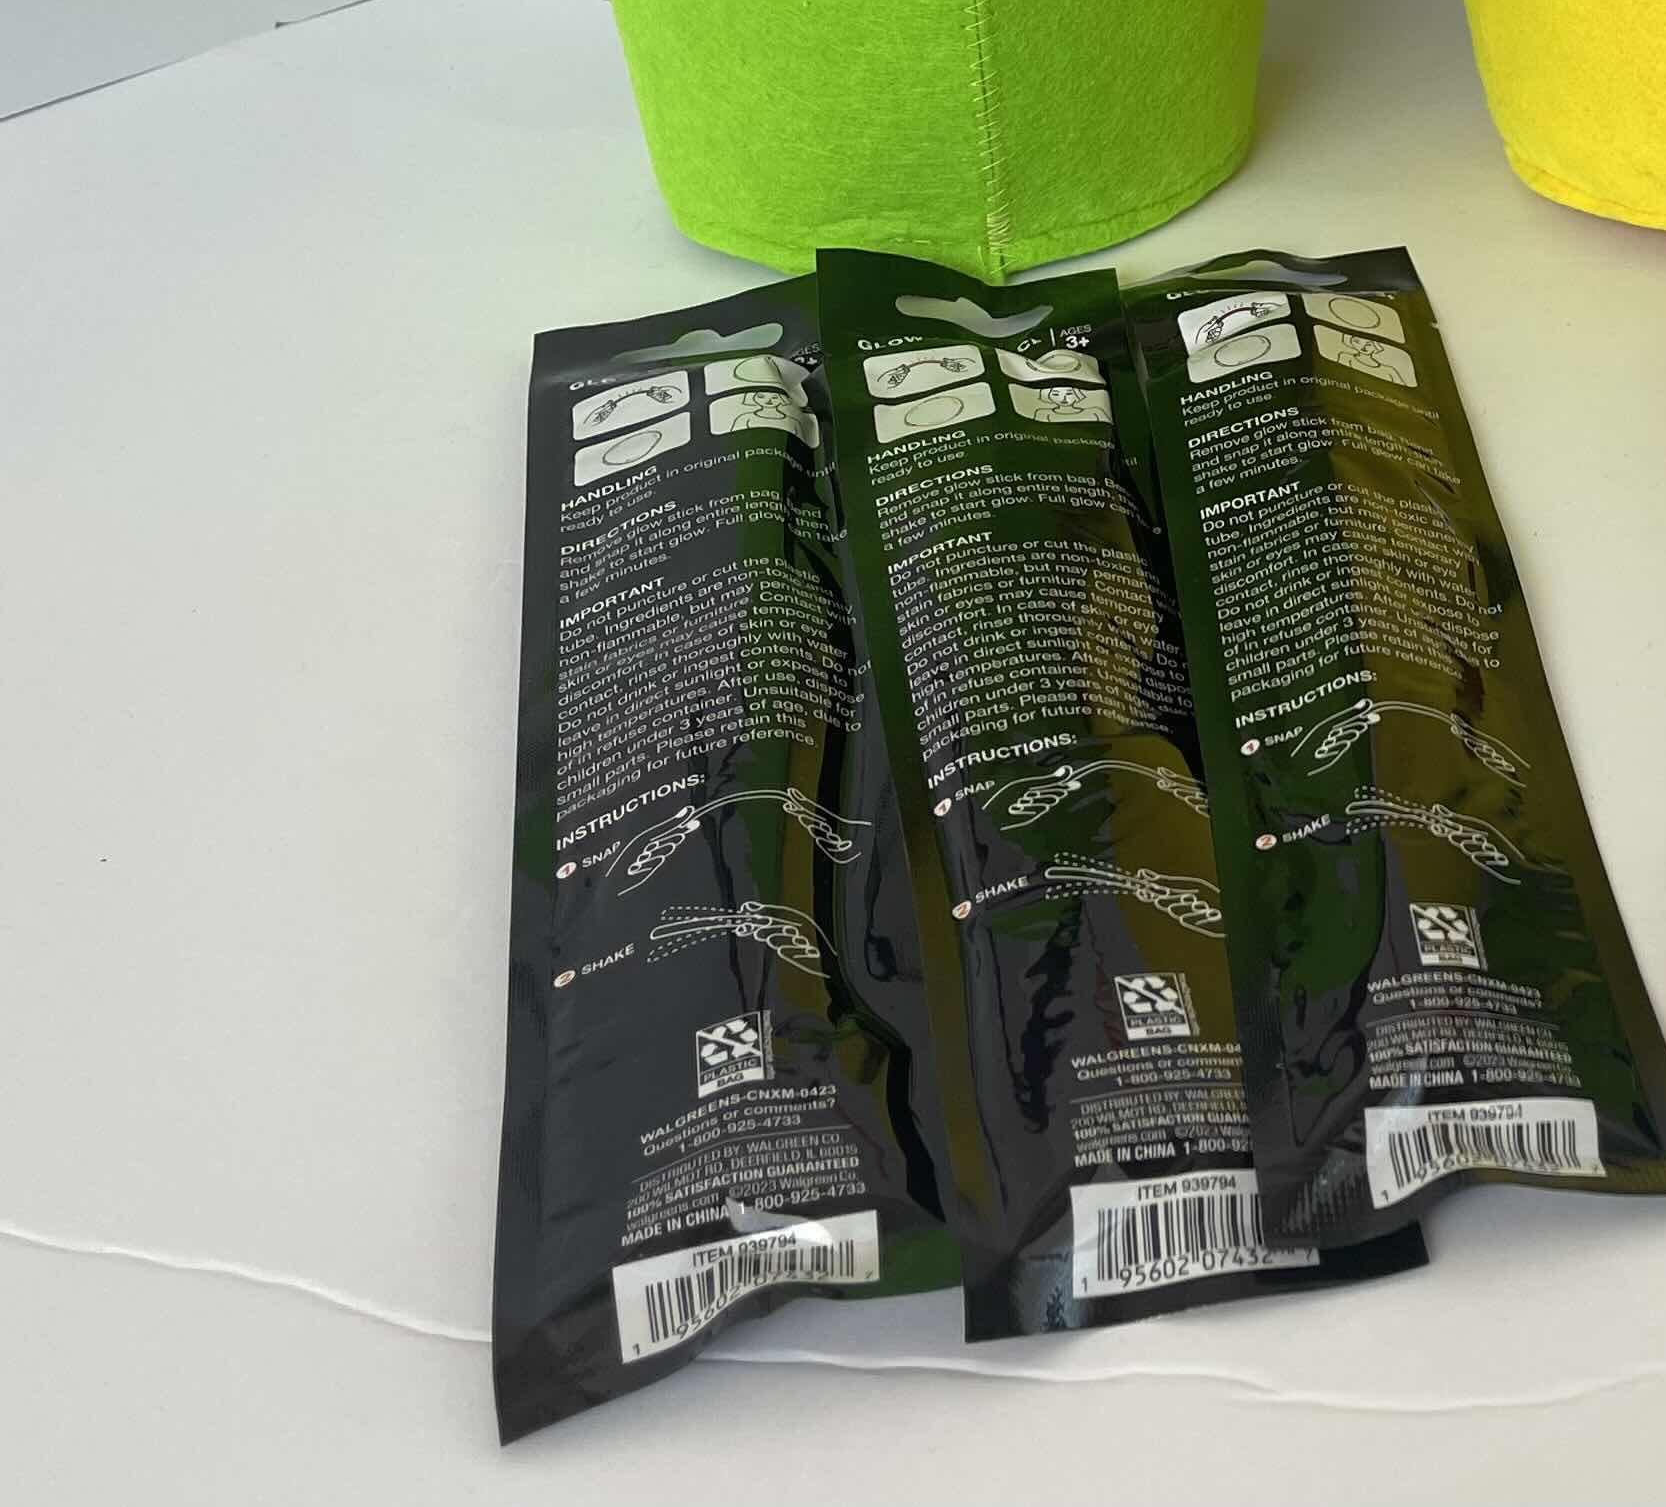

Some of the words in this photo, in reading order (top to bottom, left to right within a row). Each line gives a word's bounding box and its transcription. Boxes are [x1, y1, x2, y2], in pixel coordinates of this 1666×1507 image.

[1059, 324, 1092, 337] AGES
[1065, 335, 1090, 349] 3+
[1180, 371, 1274, 406] HANDLING
[1181, 399, 1221, 417] Keep
[1224, 379, 1279, 404] product
[1300, 376, 1351, 390] original
[1184, 408, 1224, 428] ready
[1187, 406, 1300, 449] DIRECTIONS
[867, 430, 966, 464] HANDLING
[868, 457, 909, 474] Keep
[913, 439, 973, 464] product
[1190, 434, 1251, 460] Remove
[1254, 423, 1287, 443] glow
[1292, 417, 1328, 429] stick
[560, 504, 601, 523] Keep
[606, 475, 662, 512] product
[683, 450, 740, 478] original
[560, 465, 658, 512] HANDLING
[871, 465, 912, 485] ready
[875, 465, 994, 507] DIRECTIONS
[1209, 473, 1235, 489] few
[1240, 455, 1304, 478] minutes.
[877, 487, 939, 518] Remove
[944, 478, 981, 497] glow
[986, 472, 1023, 484] stick
[1027, 472, 1063, 482] from
[1200, 481, 1300, 520] IMPORTANT
[1202, 521, 1225, 534] Do
[1229, 513, 1253, 527] not
[1258, 484, 1323, 518] puncture
[560, 514, 604, 533] ready
[560, 500, 678, 556] DIRECTIONS
[628, 543, 664, 562] start
[715, 513, 744, 529] Full
[898, 531, 926, 546] few
[929, 509, 996, 536] minutes.
[887, 532, 993, 574] IMPORTANT
[575, 583, 600, 599] few
[604, 554, 671, 582] minutes.
[559, 626, 582, 642] Do
[587, 613, 611, 628] not
[616, 582, 687, 616] puncture
[713, 561, 737, 577] cut
[559, 577, 664, 629] IMPORTANT
[605, 591, 694, 636] Ingredients
[672, 632, 761, 666] thoroughly
[1227, 656, 1271, 686] small
[1324, 631, 1378, 651] Please
[1231, 665, 1315, 702] packaging
[1319, 653, 1340, 668] for
[1344, 642, 1391, 656] future
[919, 713, 960, 745] small
[1019, 690, 1078, 707] Please
[1235, 670, 1377, 729] INSTRUCTIONS:
[922, 717, 1008, 762] packaging
[1013, 710, 1037, 726] for
[1041, 705, 1092, 718] future
[1264, 726, 1304, 746] SNAP
[556, 769, 641, 822] packaging
[647, 755, 671, 772] for
[675, 737, 728, 761] future
[927, 733, 1077, 789] INSTRUCTIONS:
[954, 780, 996, 801] SNAP
[556, 774, 706, 850] INSTRUCTIONS:
[1283, 814, 1331, 843] SHAKE
[582, 841, 621, 868] SNAP
[975, 876, 1029, 904] SHAKE
[581, 943, 635, 975] SHAKE
[1130, 1015, 1182, 1027] PLASTIC
[1145, 1025, 1172, 1035] BAG
[702, 1058, 757, 1083] PLASTIC
[716, 1073, 744, 1088] BAG
[1077, 1061, 1155, 1081] Questions
[1369, 1072, 1408, 1089] MADE
[1424, 1070, 1464, 1086] CHINA
[643, 1115, 719, 1156] Questions
[743, 1098, 836, 1116] comments?
[1111, 1111, 1205, 1135] SATISFACTION
[1428, 1108, 1466, 1121] ITEM
[680, 1115, 801, 1154] 1-800-925-4733
[1074, 1148, 1114, 1168] MADE
[1135, 1142, 1176, 1162] CHINA
[664, 1169, 764, 1203] SATISFACTION
[766, 1157, 860, 1179] GUARANTEED
[1137, 1181, 1177, 1201] ITEM
[1182, 1176, 1237, 1195] 939794
[621, 1219, 663, 1246] MADE
[686, 1204, 729, 1226] CHINA
[692, 1244, 734, 1267] ITEM
[1120, 1256, 1190, 1288] 95602
[1203, 1246, 1274, 1271] 07432
